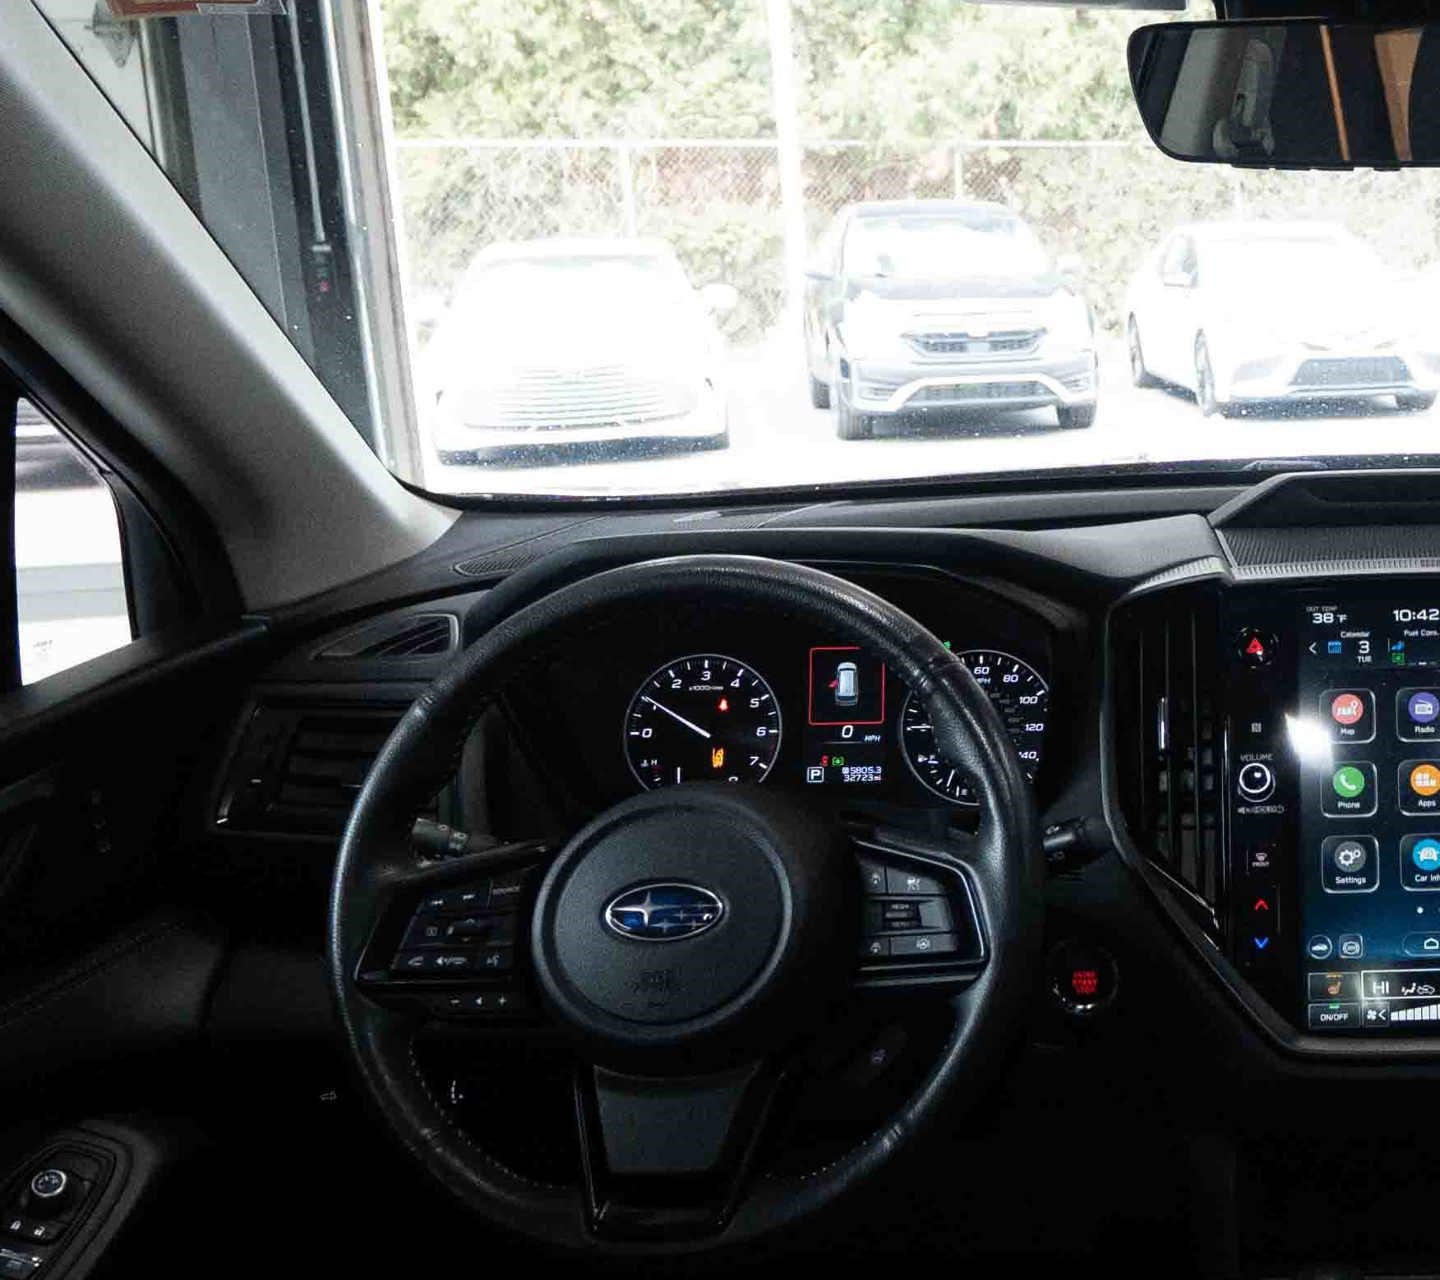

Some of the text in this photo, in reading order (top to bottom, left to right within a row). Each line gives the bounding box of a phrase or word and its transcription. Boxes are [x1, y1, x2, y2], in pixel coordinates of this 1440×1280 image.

[1312, 612, 1334, 624] 38
[1392, 608, 1440, 622] 10:42
[1359, 640, 1370, 654] 3
[1357, 655, 1373, 663] TUE
[973, 666, 990, 675] 60
[701, 671, 711, 681] 3
[1003, 675, 1019, 683] 80
[671, 679, 682, 689] 2
[729, 679, 740, 689] 4
[749, 698, 760, 708] 5
[1019, 696, 1038, 704] 100
[756, 726, 766, 737] 6
[841, 724, 854, 738] 0
[1025, 723, 1044, 732] 120
[1340, 727, 1356, 737] Map
[1414, 725, 1436, 734] Radio
[641, 728, 653, 739] 0
[749, 757, 759, 766] 7
[1240, 753, 1273, 761] VOLUME
[811, 769, 820, 780] P
[1337, 801, 1360, 809] Phone
[1418, 799, 1436, 808] Apps
[1335, 875, 1367, 885] Settings
[1414, 873, 1428, 882] Car
[1372, 981, 1390, 994] HI
[1320, 1012, 1349, 1021] ON/OFF
